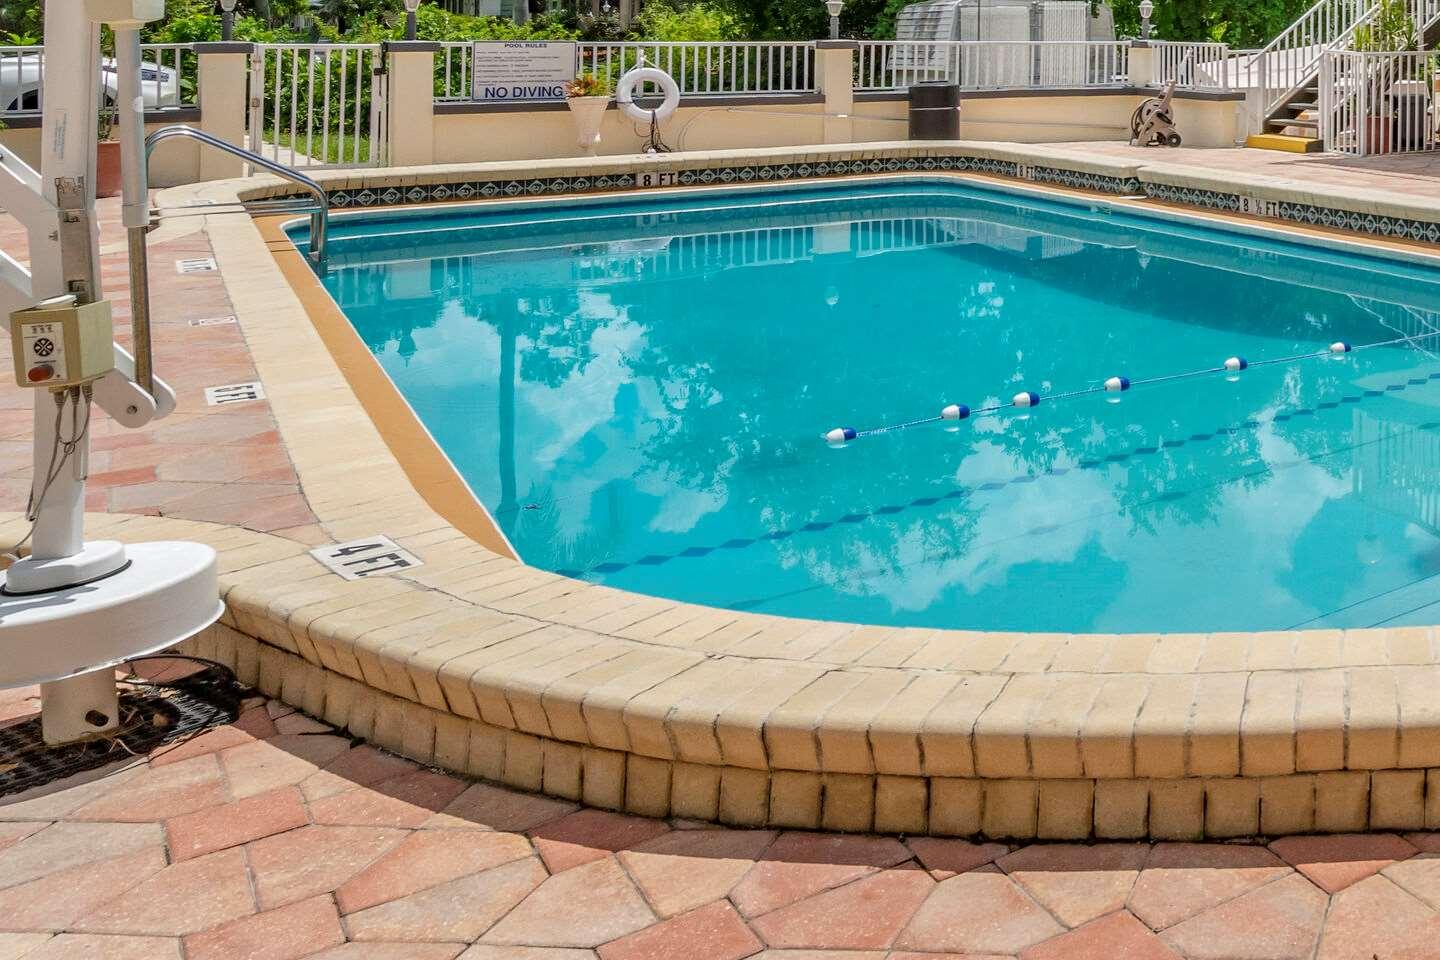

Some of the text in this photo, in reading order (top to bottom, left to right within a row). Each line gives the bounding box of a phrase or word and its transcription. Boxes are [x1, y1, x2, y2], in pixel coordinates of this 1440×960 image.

[484, 85, 564, 99] NO DIVING
[643, 172, 676, 187] 8 FT
[1243, 198, 1249, 212] 8
[330, 543, 412, 577] 4 FT.
